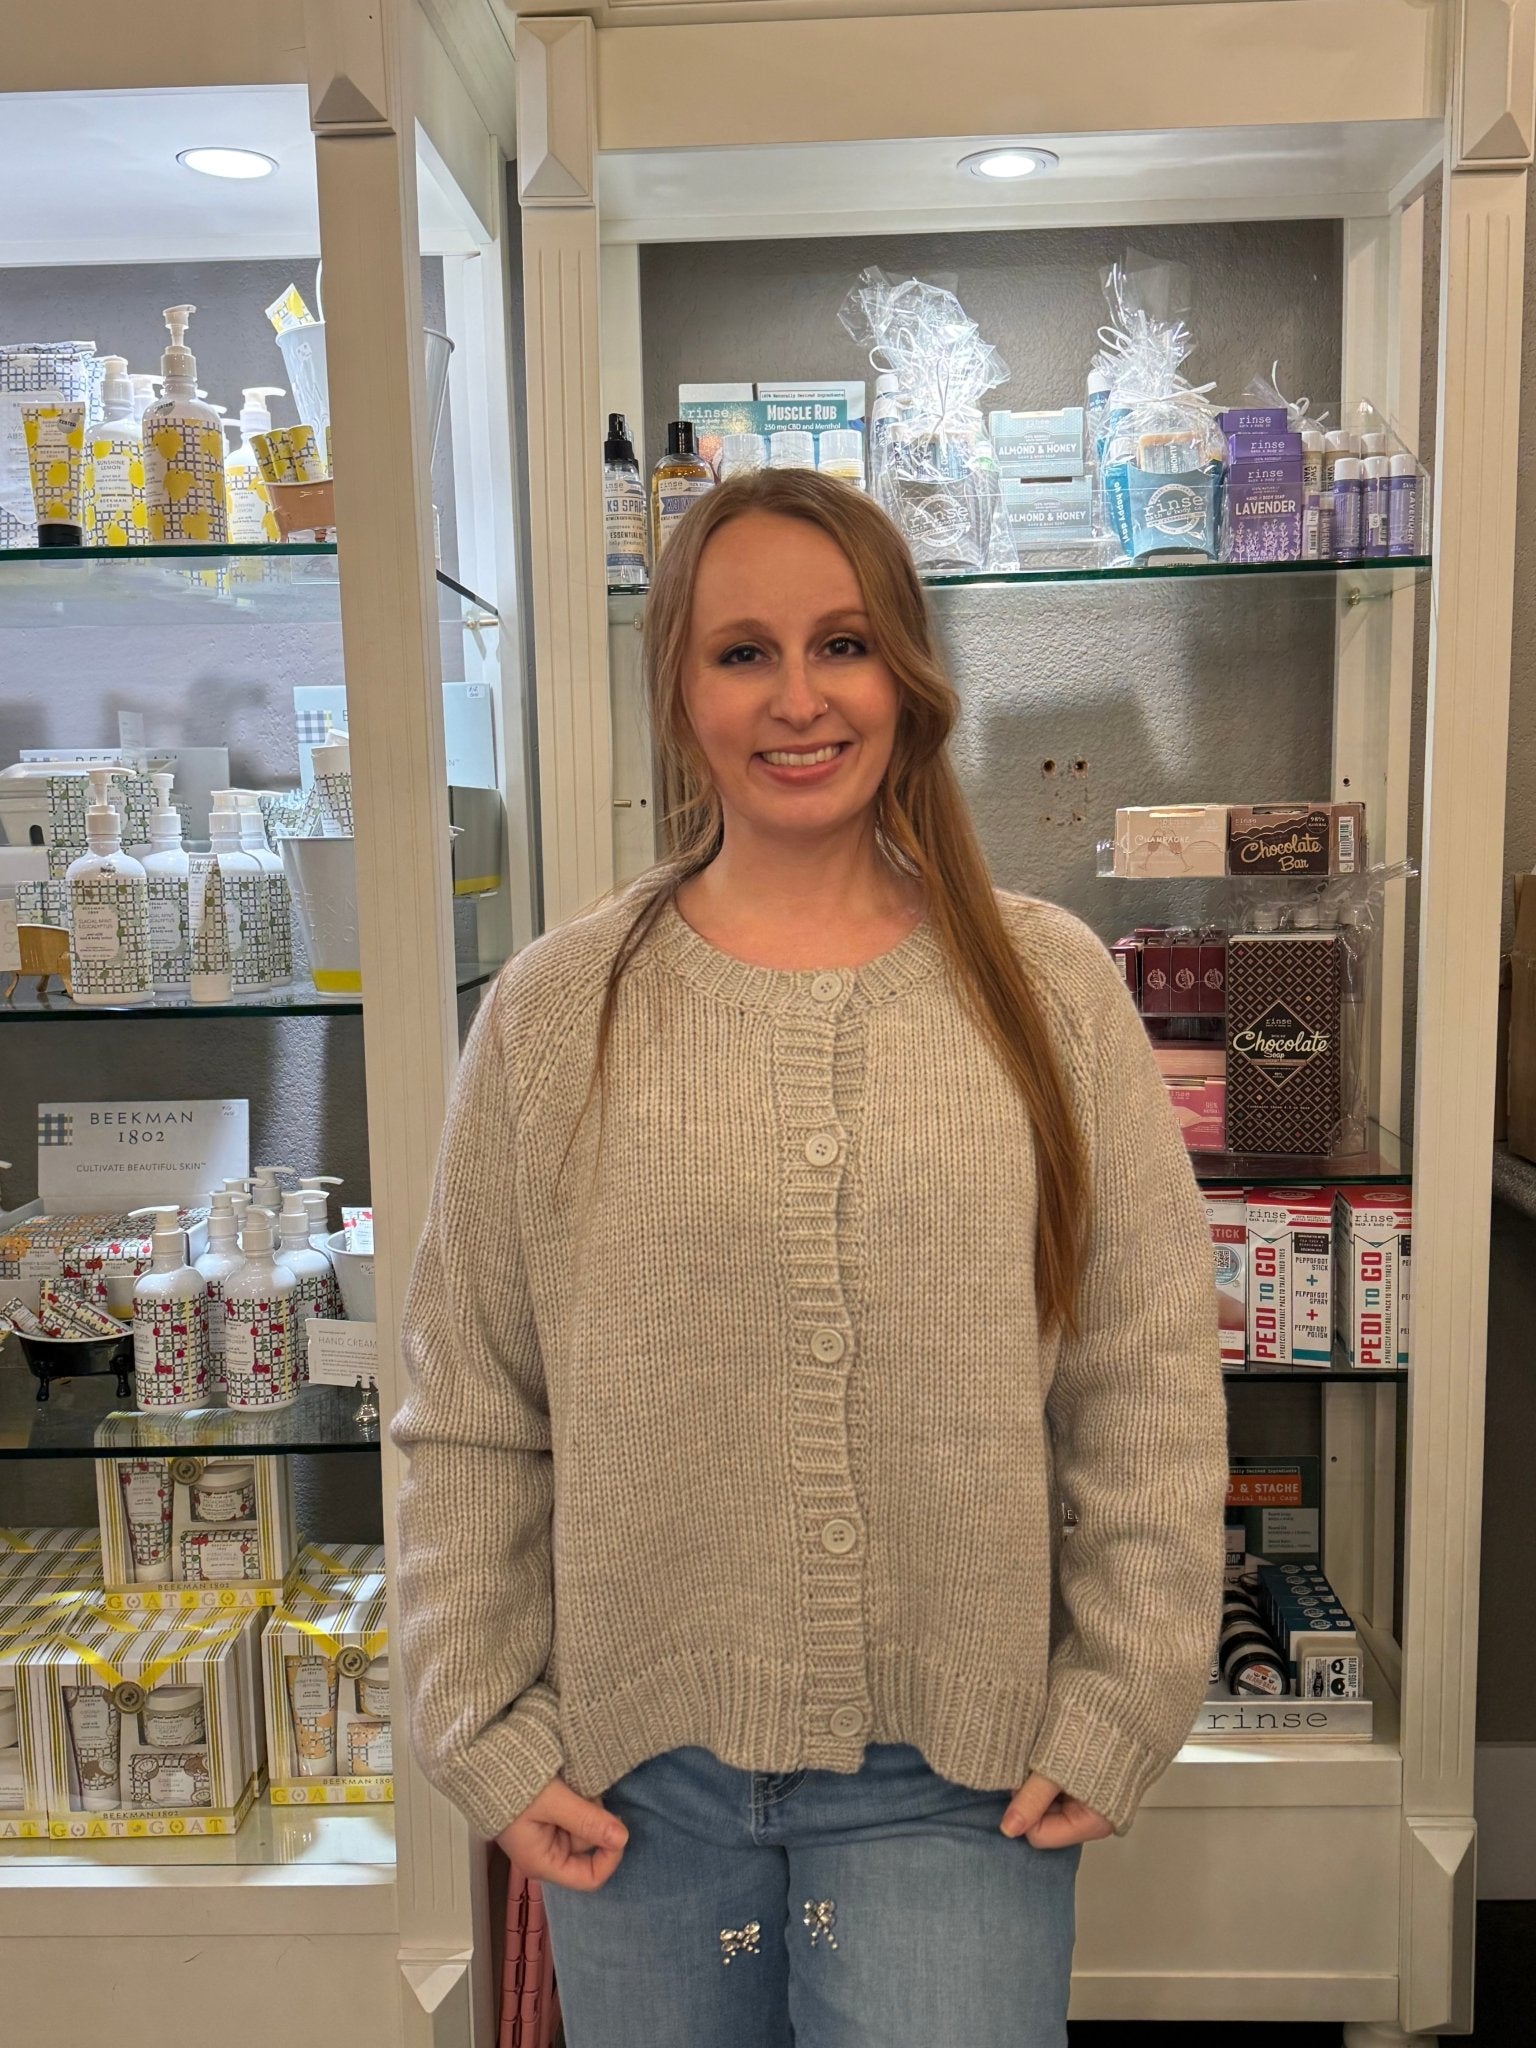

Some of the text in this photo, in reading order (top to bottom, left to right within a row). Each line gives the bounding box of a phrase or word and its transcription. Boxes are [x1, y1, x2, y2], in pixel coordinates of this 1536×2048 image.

[688, 407, 729, 418] rinse
[814, 404, 837, 420] RUB
[1239, 416, 1272, 424] rinse
[998, 443, 1077, 455] ALMOND & HONEY
[1250, 440, 1285, 449] rinse
[1247, 469, 1284, 478] rinse
[1114, 493, 1126, 521] happy
[1143, 495, 1204, 517] rinse
[1235, 500, 1296, 516] LAVENDER
[1047, 512, 1054, 521] &
[1056, 511, 1087, 520] HONEY
[1241, 833, 1321, 863] Chocolate
[1279, 856, 1309, 872] Bar
[1265, 1017, 1292, 1025] rinse
[1232, 1030, 1331, 1052] Chocolate
[1263, 1049, 1285, 1062] Soap
[90, 1111, 194, 1125] BEEKMAN
[118, 1130, 165, 1145] 1802
[76, 1164, 125, 1173] CULTIVATE
[127, 1163, 177, 1172] BEAUTIFUL
[1249, 1209, 1287, 1219] rinse
[1355, 1213, 1394, 1222] rinse
[1256, 1247, 1276, 1359] PEDI TO GO
[1360, 1252, 1382, 1364] PEDI TO GO
[318, 1337, 345, 1346] HAND
[1240, 1483, 1248, 1493] &
[1255, 1483, 1299, 1494] STACHE
[158, 1583, 206, 1591] BEEKMAN
[1207, 1707, 1328, 1730] rinse
[103, 1810, 154, 1820] BEEKMAN
